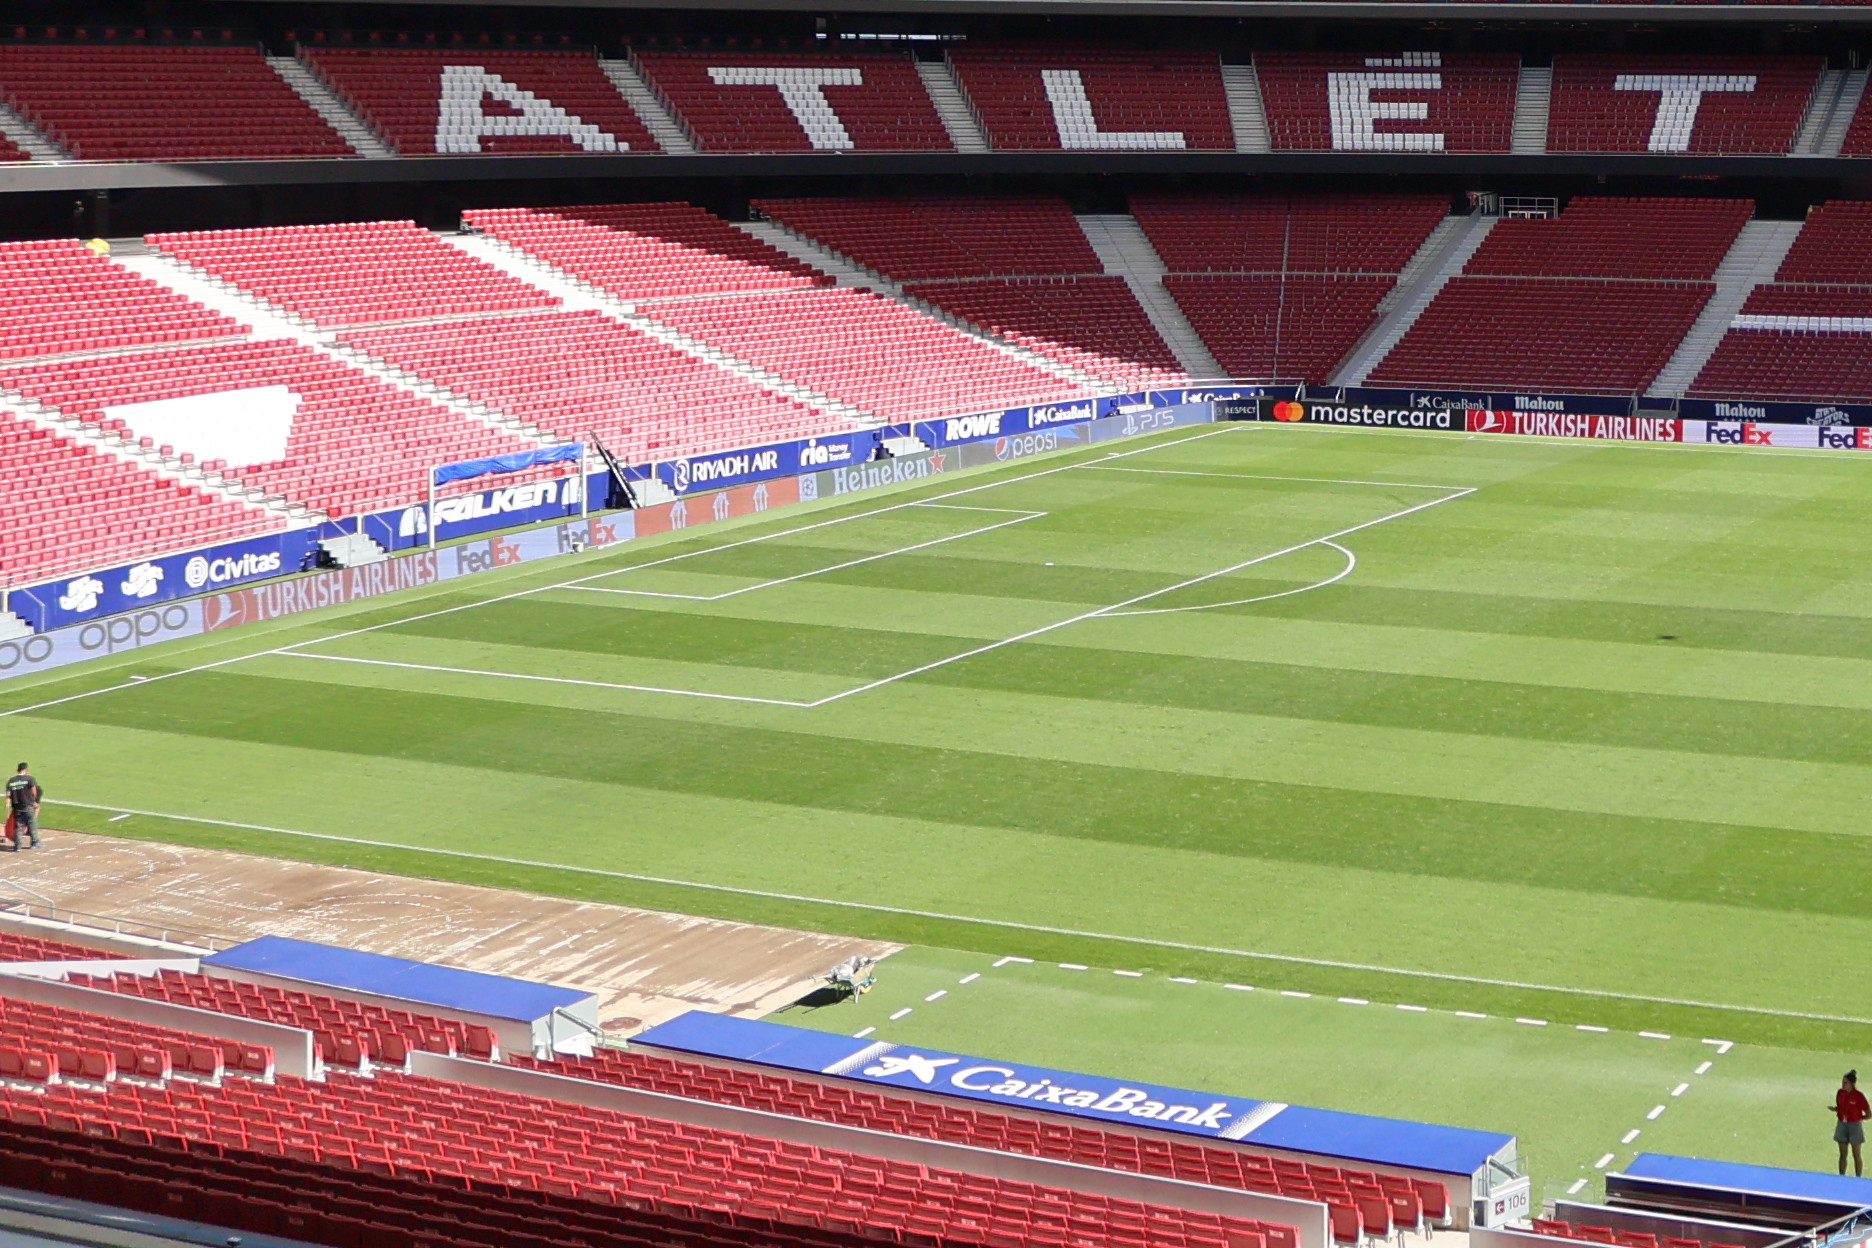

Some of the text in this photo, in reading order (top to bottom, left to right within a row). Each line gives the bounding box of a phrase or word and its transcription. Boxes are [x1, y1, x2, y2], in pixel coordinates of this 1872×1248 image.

[1047, 404, 1092, 421] CaixaBank
[1224, 406, 1257, 414] RESPECT
[1311, 404, 1451, 428] mastercard
[1433, 396, 1485, 411] CaixaBank
[1514, 396, 1564, 411] Mahou
[1715, 403, 1766, 418] Mahou
[946, 412, 1001, 440] ROWE
[1140, 410, 1175, 430] PS5
[1512, 412, 1676, 442] TURKISH AIRLINES
[1706, 421, 1773, 445] FedEx
[800, 439, 828, 466] ria
[1013, 431, 1058, 456] pepsi
[693, 451, 778, 483] RIYADH AIR
[833, 456, 929, 496] Heineken
[209, 552, 281, 582] Cívitas
[457, 537, 522, 575] FedEx
[253, 552, 437, 621] TURKISH AIRLINES
[79, 605, 189, 653] oppo
[951, 1065, 1233, 1130] CaixaBank
[1509, 1192, 1527, 1210] 106
